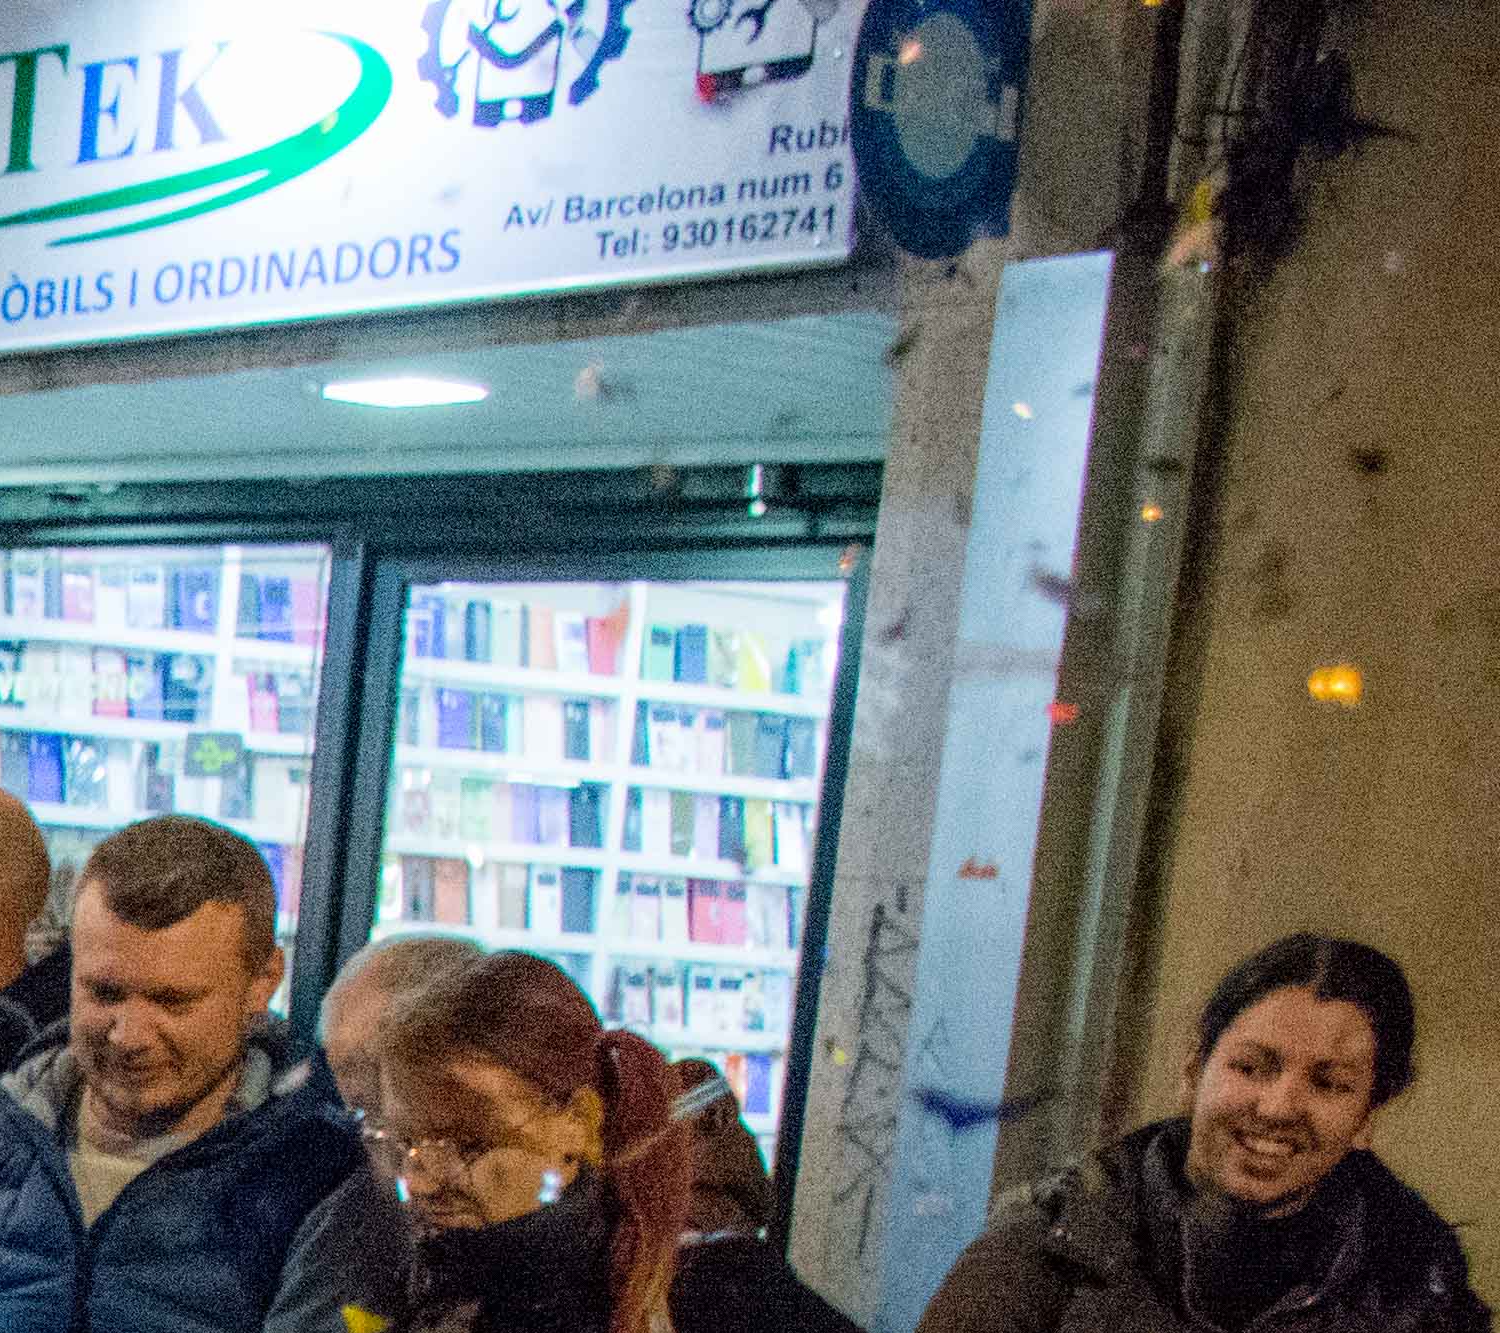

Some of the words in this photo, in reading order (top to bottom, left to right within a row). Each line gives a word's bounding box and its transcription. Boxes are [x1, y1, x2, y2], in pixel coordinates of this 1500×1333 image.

[563, 180, 726, 224] Barcelona
[823, 162, 845, 192] 6
[596, 228, 650, 260] Tel:
[661, 203, 838, 251] 930162741
[129, 270, 139, 308] I
[152, 228, 462, 305] ORDINADORS
